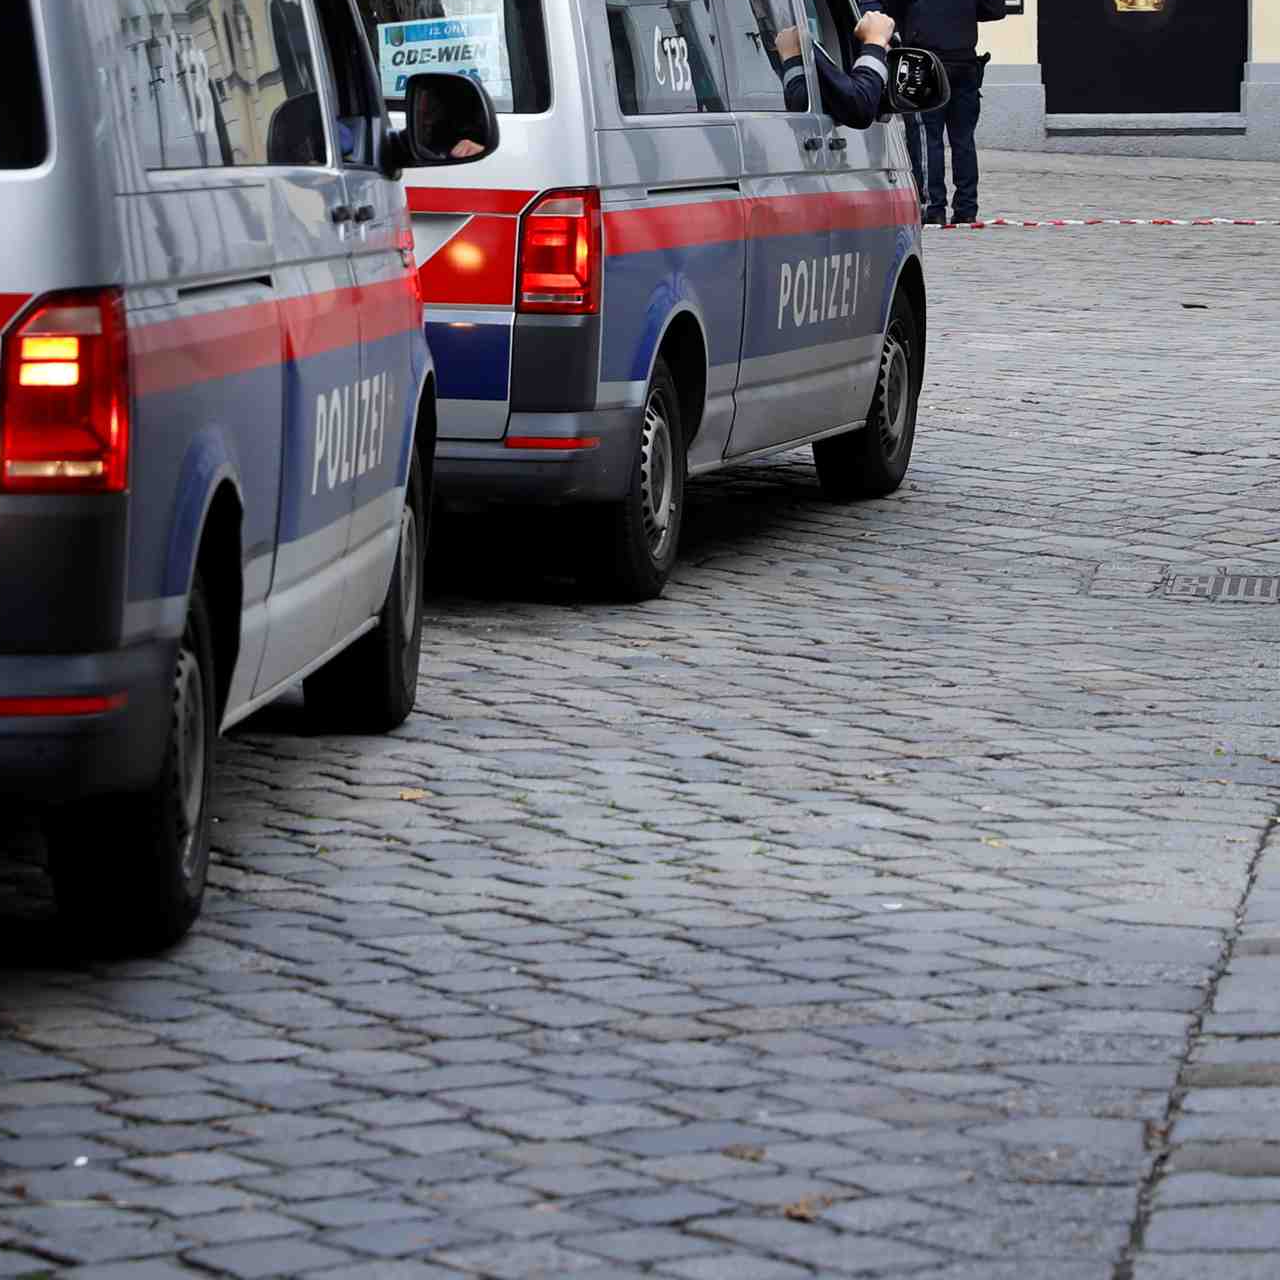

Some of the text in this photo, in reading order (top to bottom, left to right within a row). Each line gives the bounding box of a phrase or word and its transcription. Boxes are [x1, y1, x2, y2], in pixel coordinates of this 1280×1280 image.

[663, 37, 693, 91] 133
[777, 251, 860, 330] POLIZEI
[311, 371, 387, 496] POLIZEI
